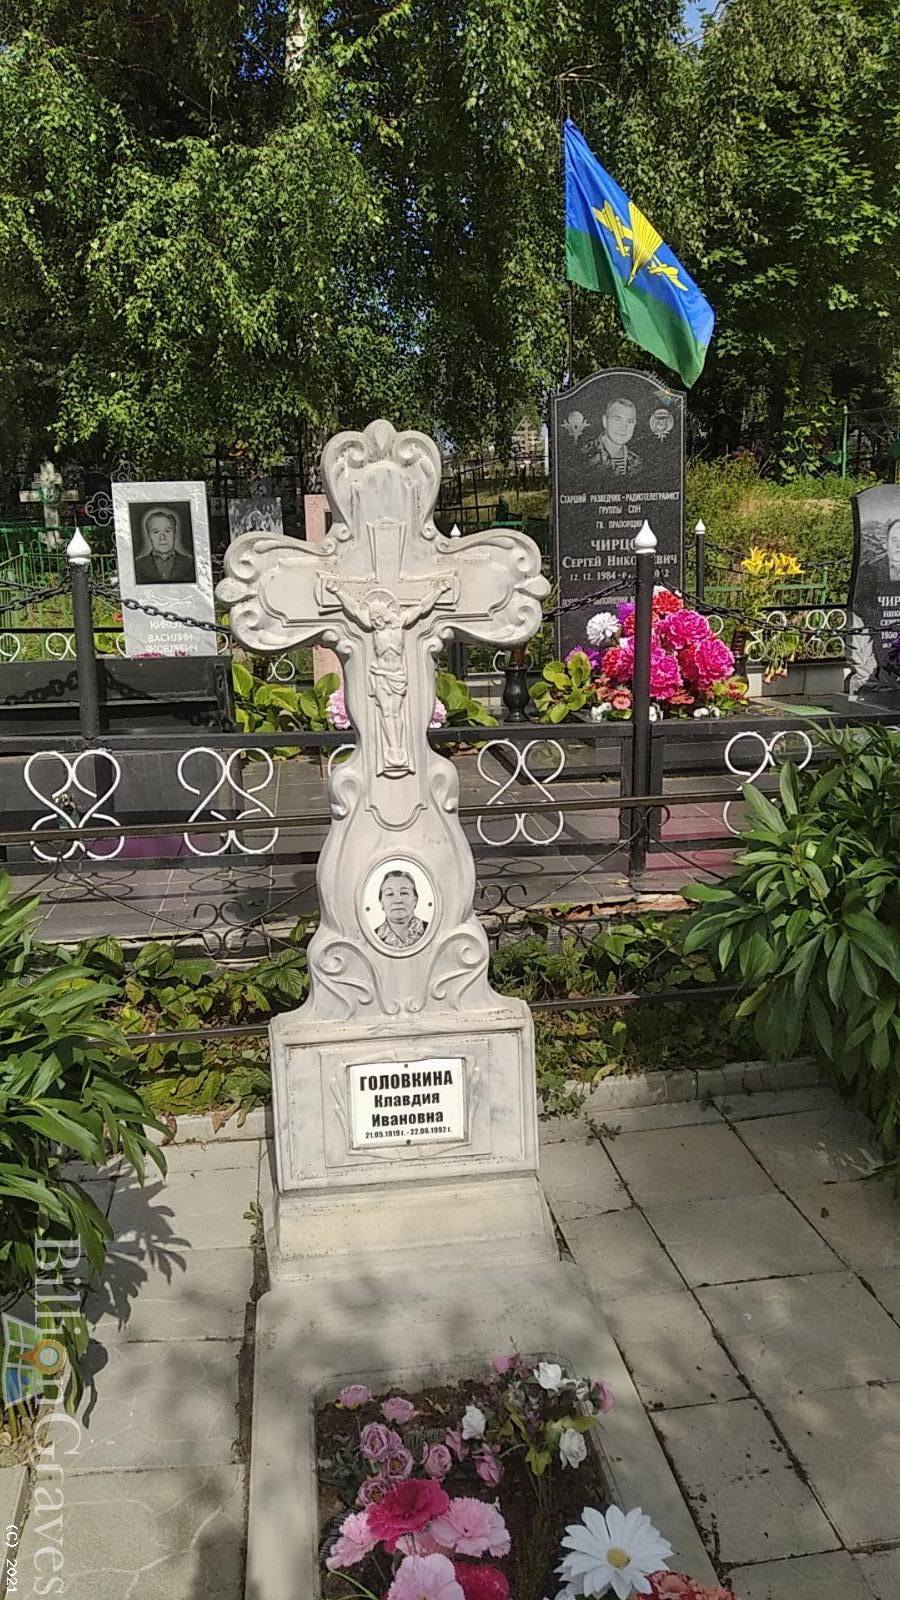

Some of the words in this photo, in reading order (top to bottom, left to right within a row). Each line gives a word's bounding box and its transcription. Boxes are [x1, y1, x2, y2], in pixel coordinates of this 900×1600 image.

[598, 505, 622, 515] ГРУППЫ
[627, 504, 642, 514] СПН
[590, 538, 638, 552] ЧИРЦО
[877, 596, 900, 606] ЧИР
[359, 1070, 454, 1092] ГОЛОВКИНА
[374, 1092, 440, 1109] Клавдия
[371, 1111, 444, 1128] Ивановна
